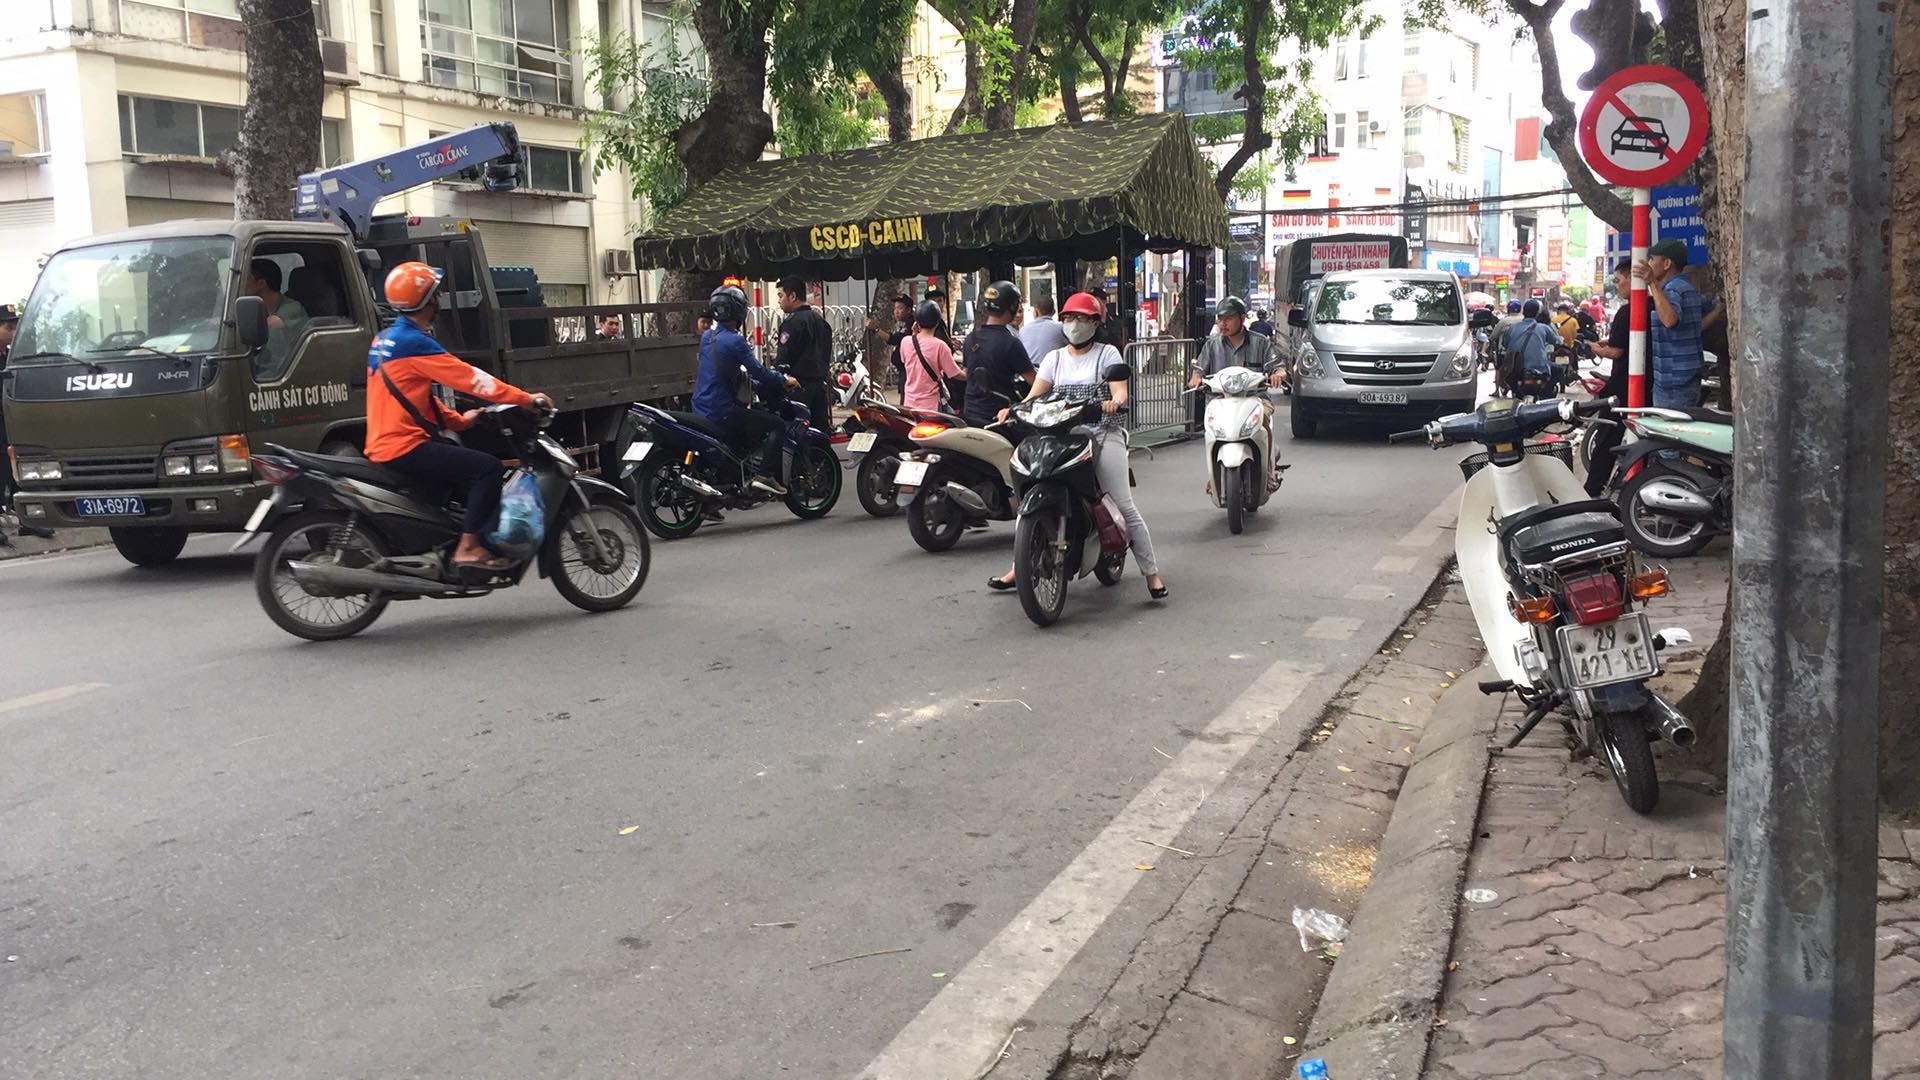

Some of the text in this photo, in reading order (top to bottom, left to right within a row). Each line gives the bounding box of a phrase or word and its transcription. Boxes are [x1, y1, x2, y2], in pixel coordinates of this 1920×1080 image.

[420, 153, 445, 169] CARGO
[446, 145, 469, 161] CRANE
[1321, 262, 1343, 271] 0916
[66, 372, 133, 392] ISUZU
[158, 371, 189, 380] NKR
[1551, 537, 1597, 552] HONDA
[1593, 624, 1616, 652] 29
